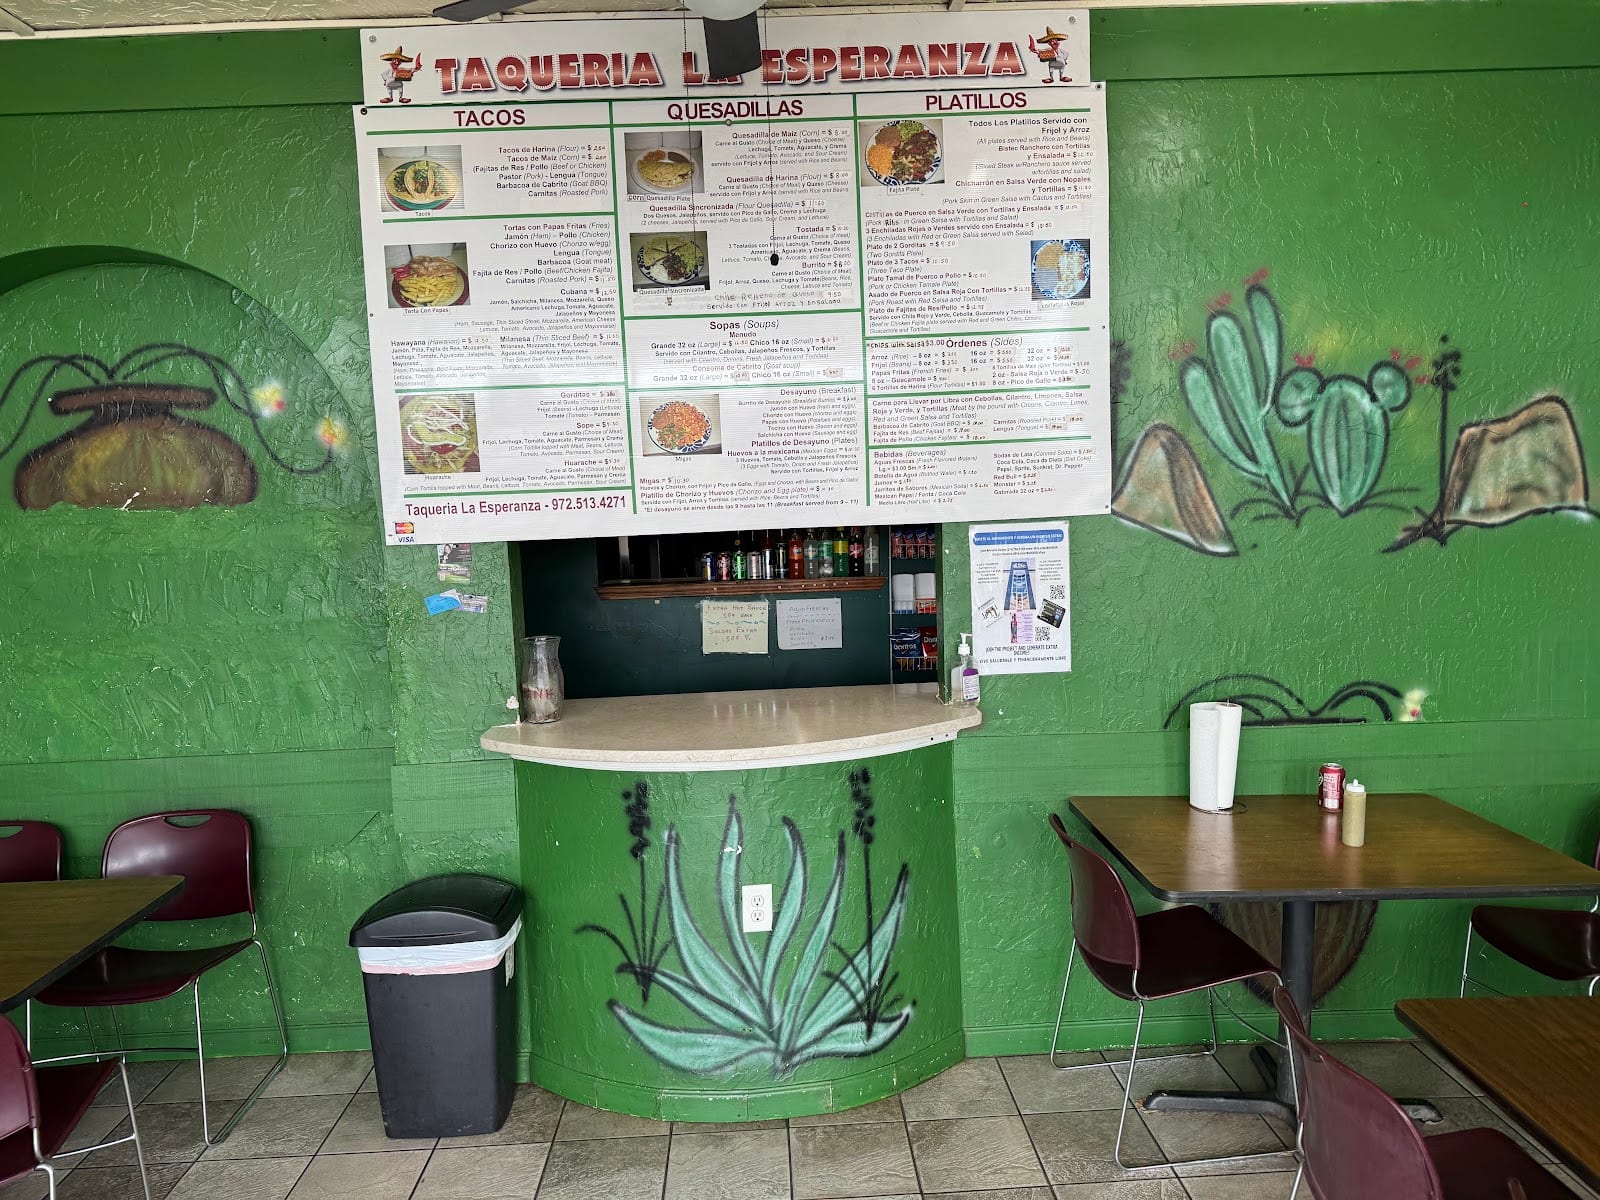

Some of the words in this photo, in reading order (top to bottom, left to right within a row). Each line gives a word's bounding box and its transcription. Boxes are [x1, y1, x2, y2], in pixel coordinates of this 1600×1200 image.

[435, 51, 664, 93] TAQUERIA
[760, 42, 1025, 85] ESPERANZA
[925, 92, 1028, 111] PLATILLOS
[667, 100, 803, 121] QUESADILLAS
[454, 109, 525, 127] TACOS
[968, 119, 992, 127] Todos
[1010, 118, 1040, 126] Platillos
[1043, 117, 1071, 125] Servido
[732, 131, 769, 140] Quesadilla
[799, 130, 820, 139] (Corn)
[1042, 127, 1060, 136] Frijol
[498, 146, 519, 154] Tacos
[532, 145, 556, 153] Harina
[558, 144, 579, 154] (Flour)
[1066, 142, 1090, 150] Tortillas
[530, 154, 538, 162] de
[559, 153, 579, 162] (Corn)
[498, 172, 522, 180] Pastor
[524, 172, 544, 181] (Pork)
[550, 171, 576, 181] Lengua
[578, 171, 607, 180] (Tongue)
[726, 175, 764, 184] Quesadilla
[800, 173, 822, 182] (Flour)
[1064, 176, 1090, 185] Nopales
[496, 181, 530, 189] Barbacoa
[542, 180, 568, 188] Cabrito
[528, 189, 558, 197] Carnitas
[1032, 187, 1036, 195] y
[1038, 185, 1065, 193] Tortillas
[650, 204, 686, 213] Quesadilla
[688, 202, 734, 210] Sincronizada
[543, 223, 564, 232] Papas
[588, 222, 610, 231] (Fries)
[796, 225, 824, 233] Tostada
[530, 232, 551, 241] (Ham)
[580, 231, 611, 240] (Chicken)
[590, 240, 611, 248] w/egg)
[553, 249, 580, 258] Lengua
[582, 248, 612, 257] (Tongue)
[572, 258, 592, 266] (Goat
[594, 257, 612, 266] meat)
[472, 269, 492, 277] Fajita
[592, 266, 612, 275] Fajita)
[506, 276, 536, 284] Carnitas
[538, 275, 567, 285] (Roasted
[568, 275, 586, 284] Pork)
[710, 320, 740, 331] Sopas
[743, 320, 779, 331] (Soups)
[652, 341, 676, 349] Grande
[946, 338, 988, 347] Órdenes
[990, 337, 1023, 348] (Sides)
[560, 390, 590, 398] Gorditas
[780, 388, 817, 397] Desayuno
[818, 388, 857, 397] (Breakfast)
[576, 422, 594, 430] Sope
[793, 438, 830, 447] Desayuno
[832, 438, 858, 447] (Plates)
[905, 449, 946, 458] (Beverages)
[564, 458, 596, 466] Huarache
[640, 477, 660, 485] Migas
[641, 491, 664, 499] Platillo
[405, 502, 458, 520] Taqueria
[461, 501, 476, 514] La
[479, 498, 541, 517] Esperanza
[552, 495, 626, 510] 972.513.4271
[893, 643, 917, 651] Doritos
